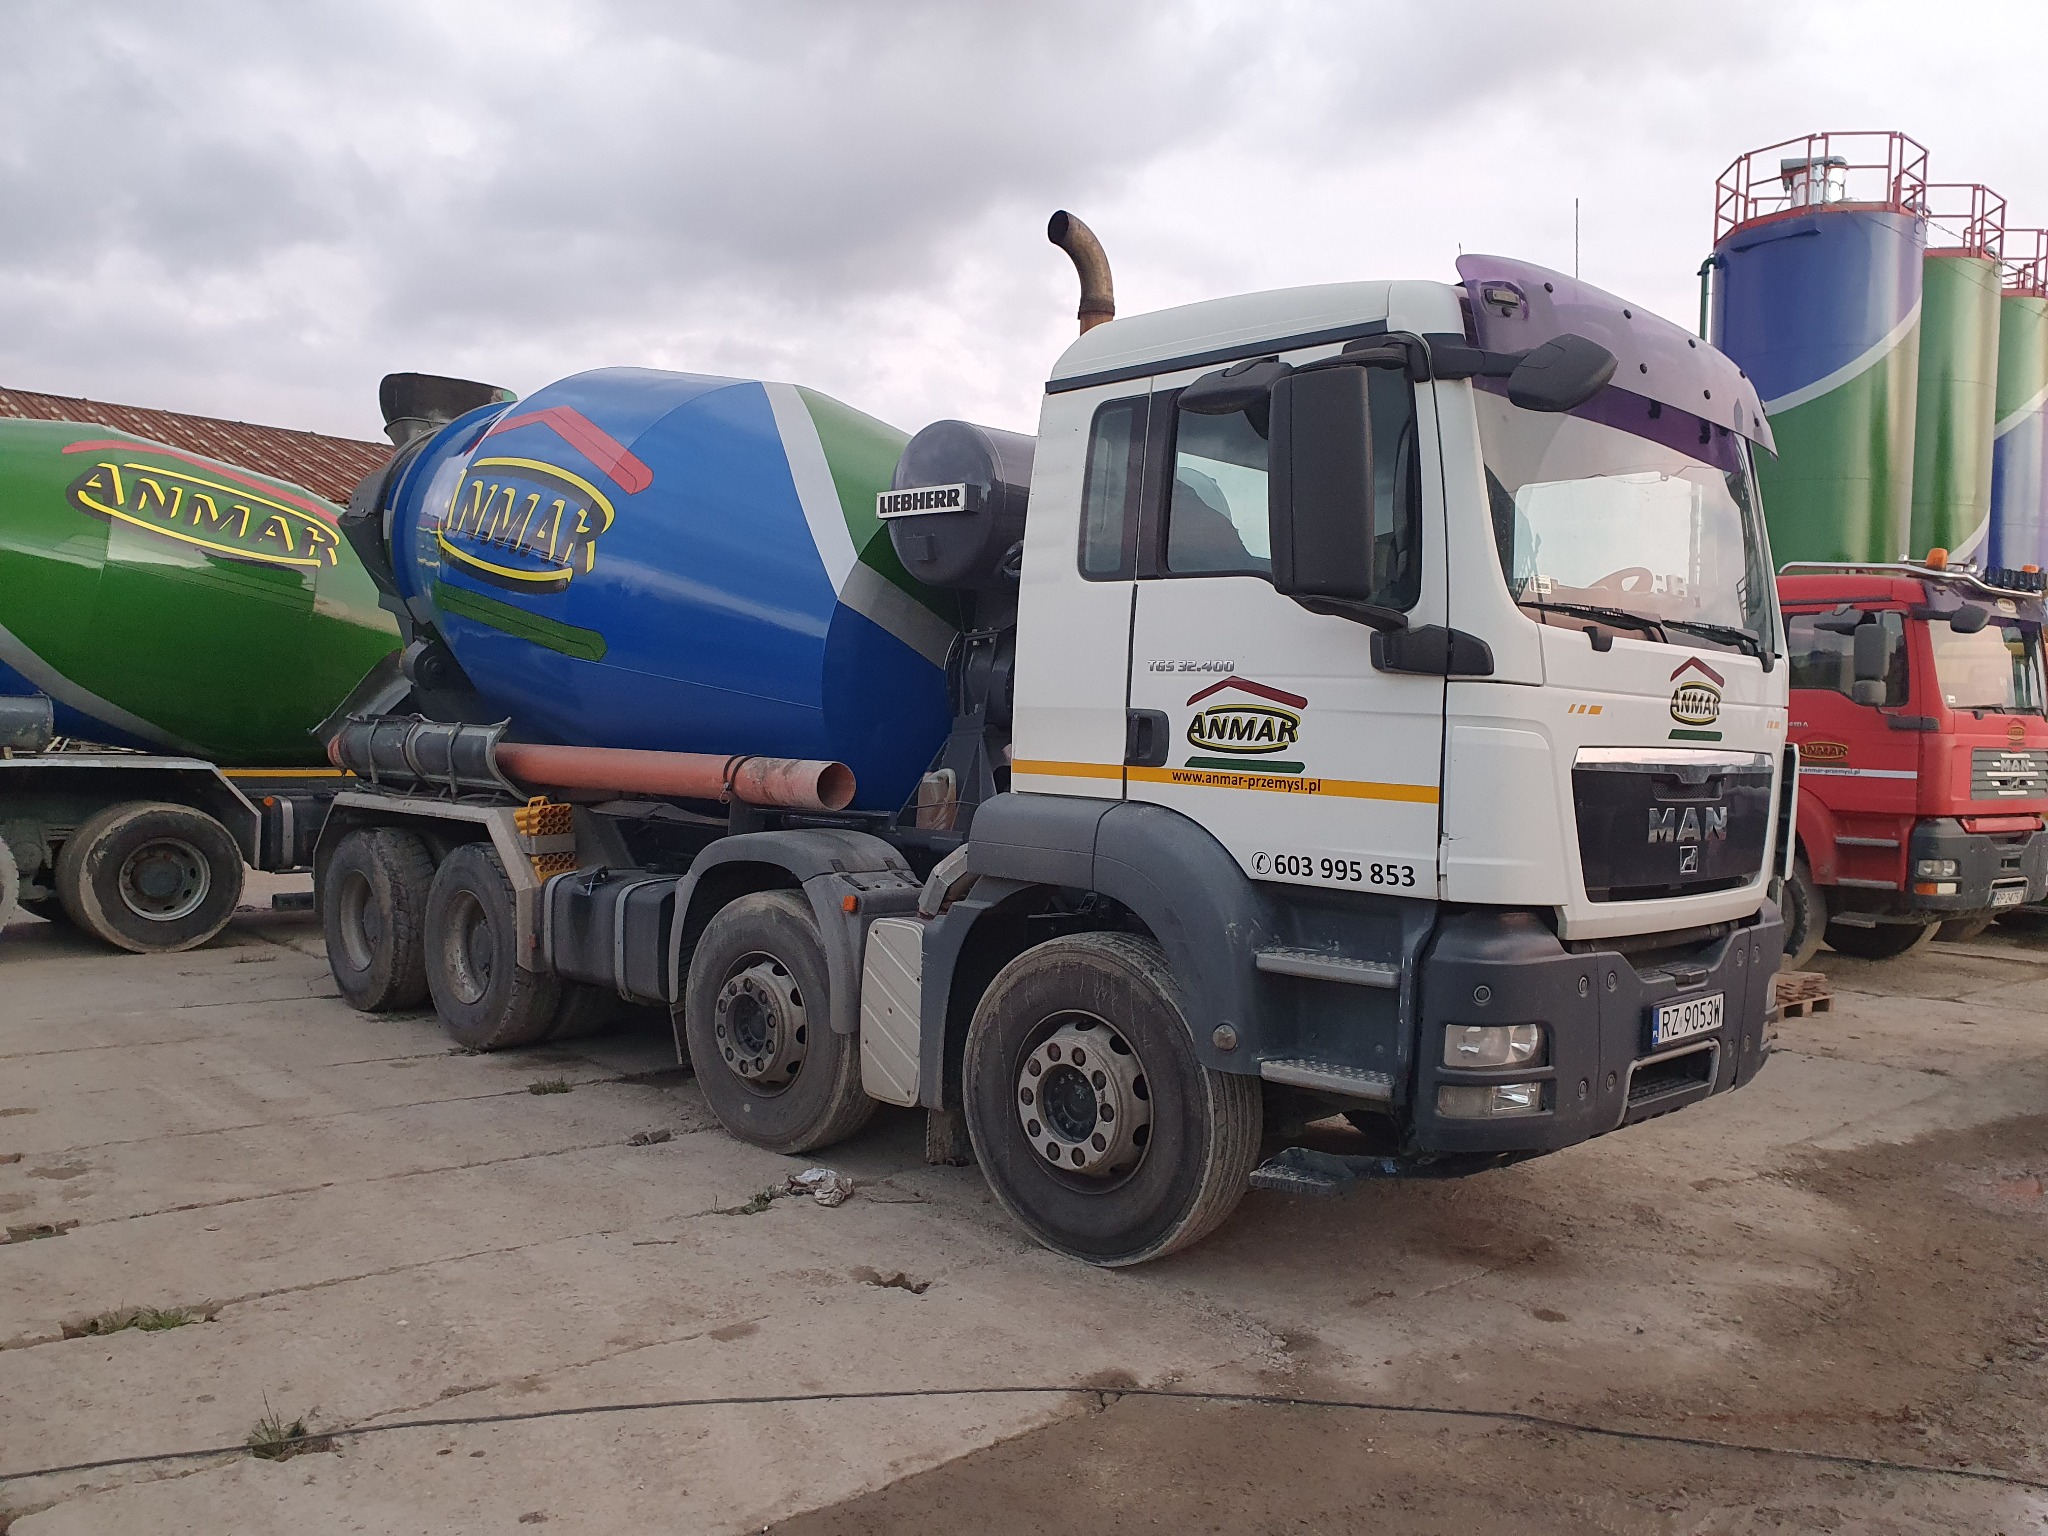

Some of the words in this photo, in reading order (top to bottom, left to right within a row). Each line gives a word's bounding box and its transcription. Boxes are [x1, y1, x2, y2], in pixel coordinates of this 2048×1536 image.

[68, 462, 340, 567] ANMAR
[880, 488, 961, 514] LIEBHERR
[1148, 660, 1175, 672] TGS
[1177, 660, 1235, 673] 32.400
[1670, 687, 1721, 716] ANMAR
[1187, 711, 1300, 743] ANMAR
[1799, 743, 1848, 756] ANMAR
[2000, 759, 2030, 772] MAN
[1172, 771, 1321, 794] www.anmar-przemysl.pl
[1647, 806, 1728, 844] MAN
[1274, 854, 1314, 877] 603
[1320, 858, 1363, 882] 995
[1370, 863, 1416, 887] 853
[1661, 1008, 1680, 1038] RZ
[1684, 998, 1720, 1033] 9053W
